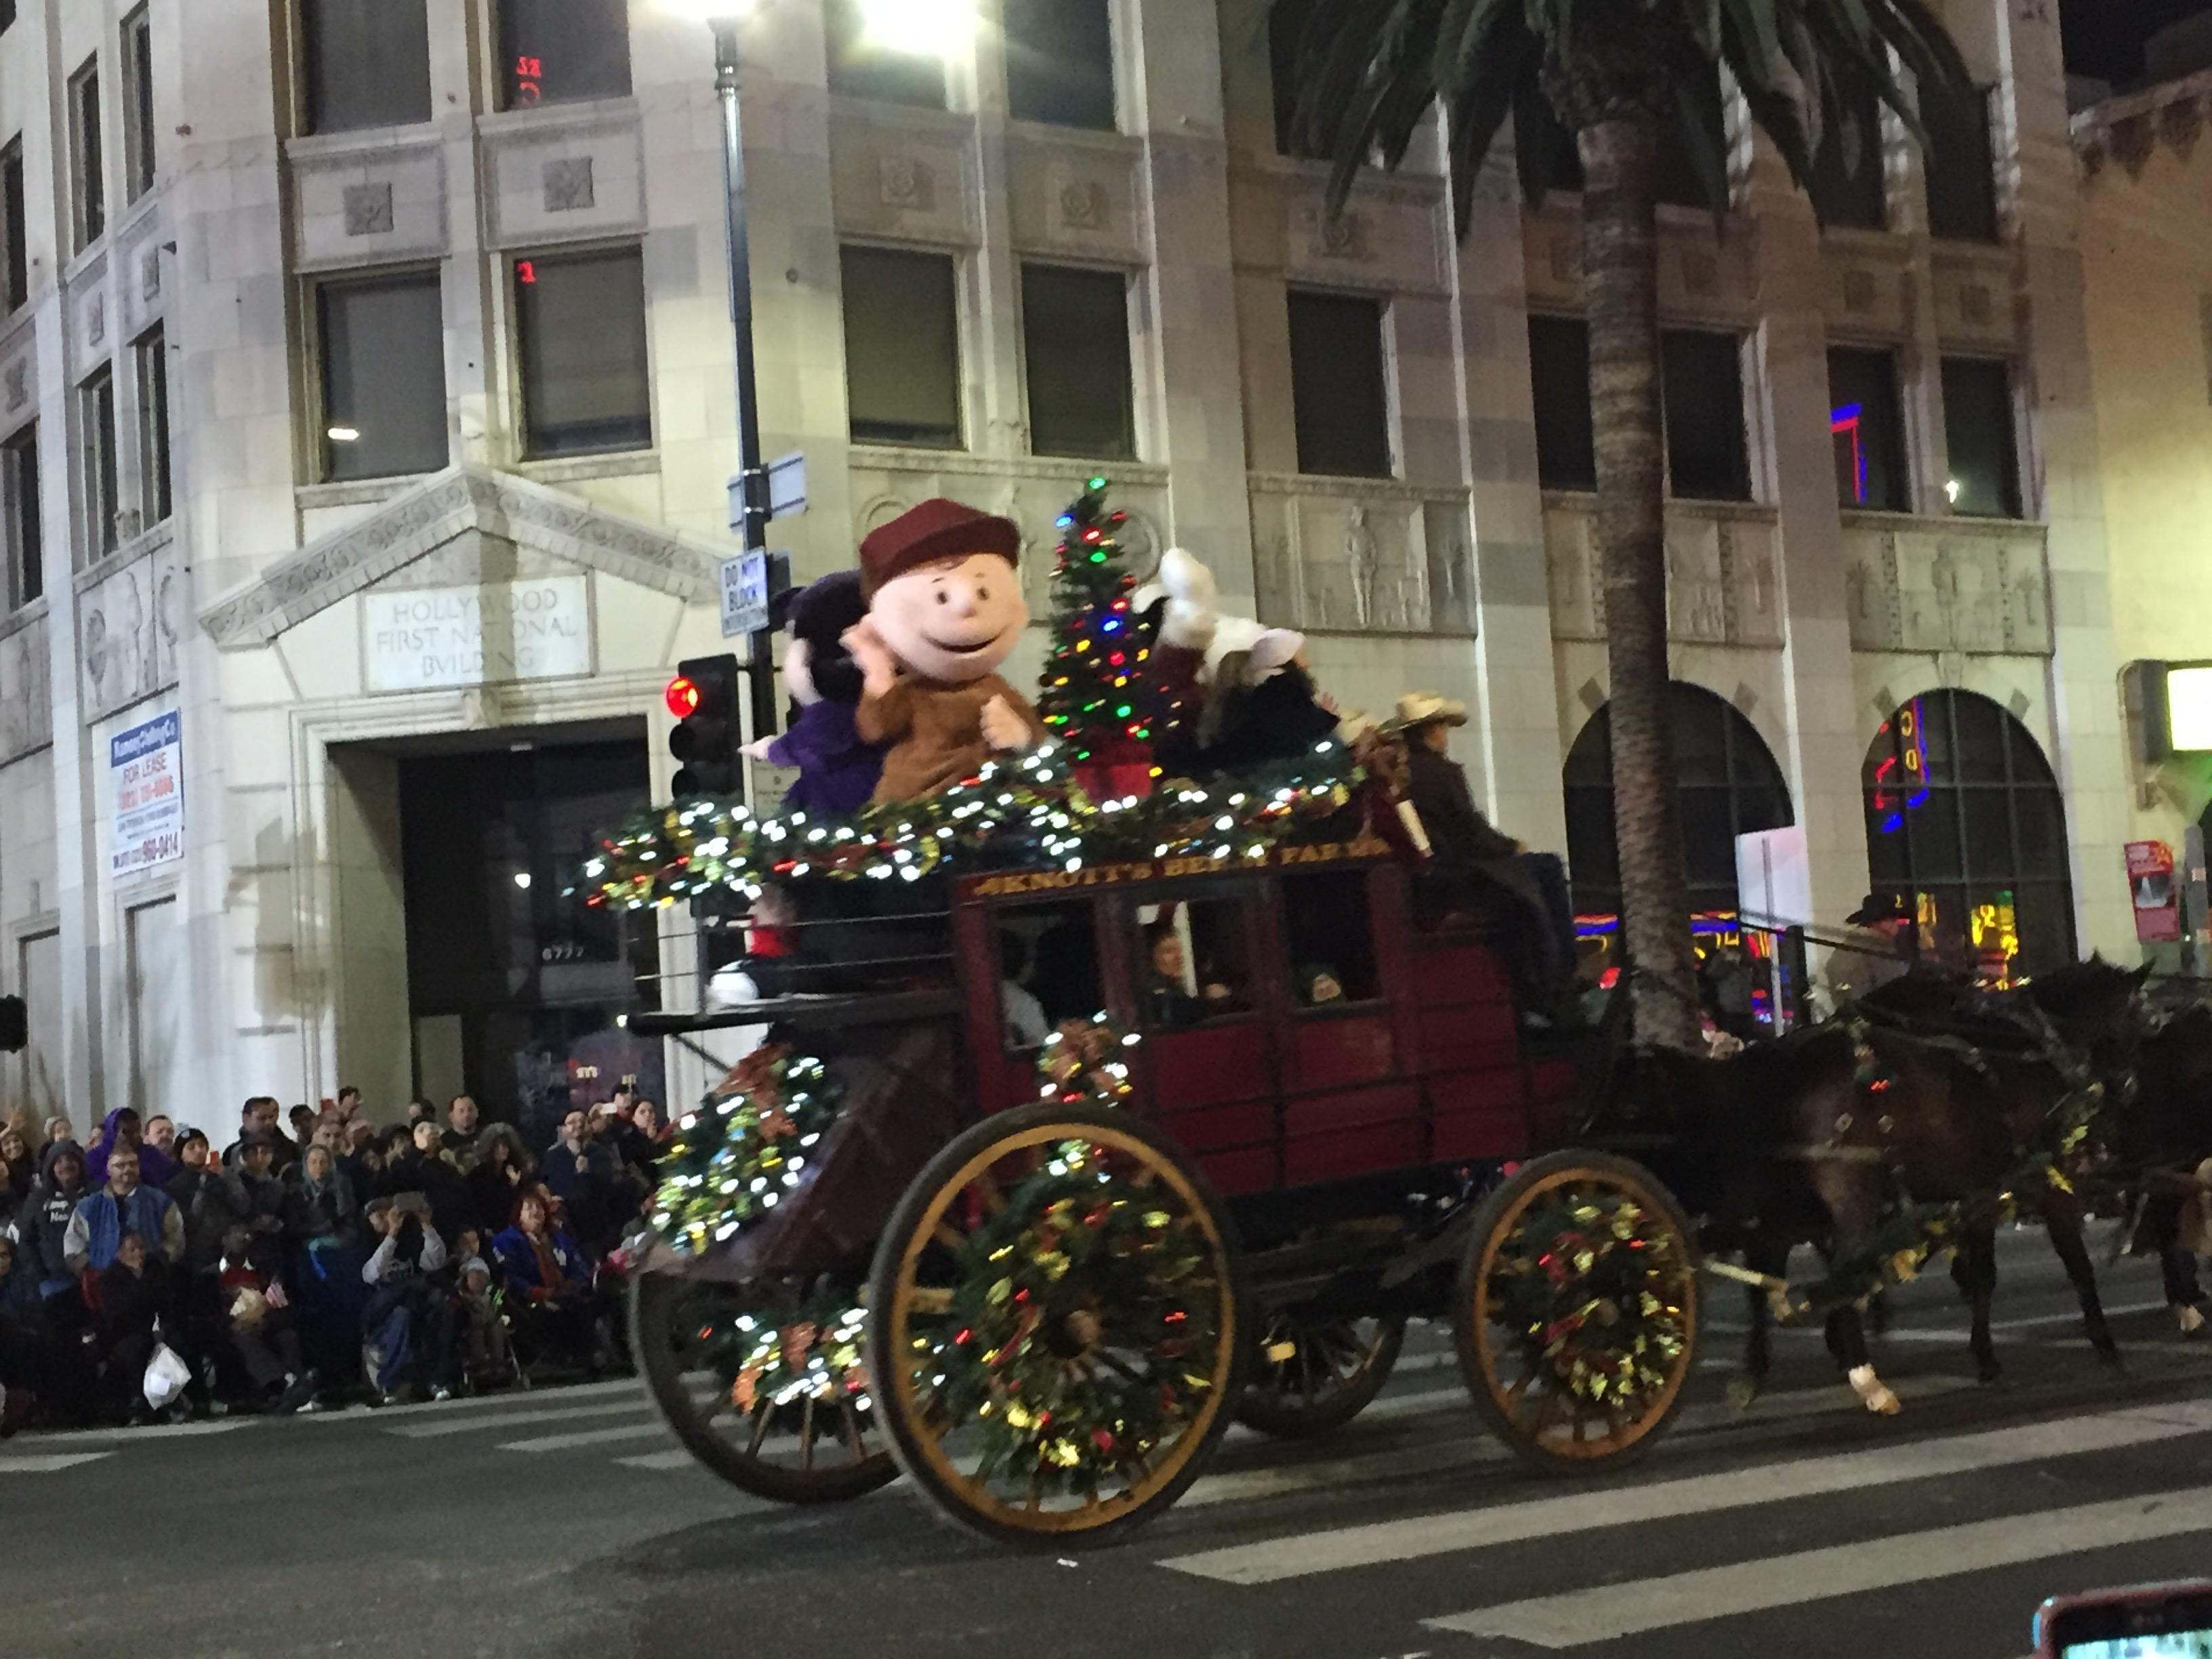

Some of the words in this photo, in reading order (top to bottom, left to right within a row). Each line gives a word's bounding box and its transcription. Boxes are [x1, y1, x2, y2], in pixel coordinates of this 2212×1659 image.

[376, 626, 440, 653] FIRST
[123, 763, 140, 784] FOR
[142, 752, 167, 777] LEASE
